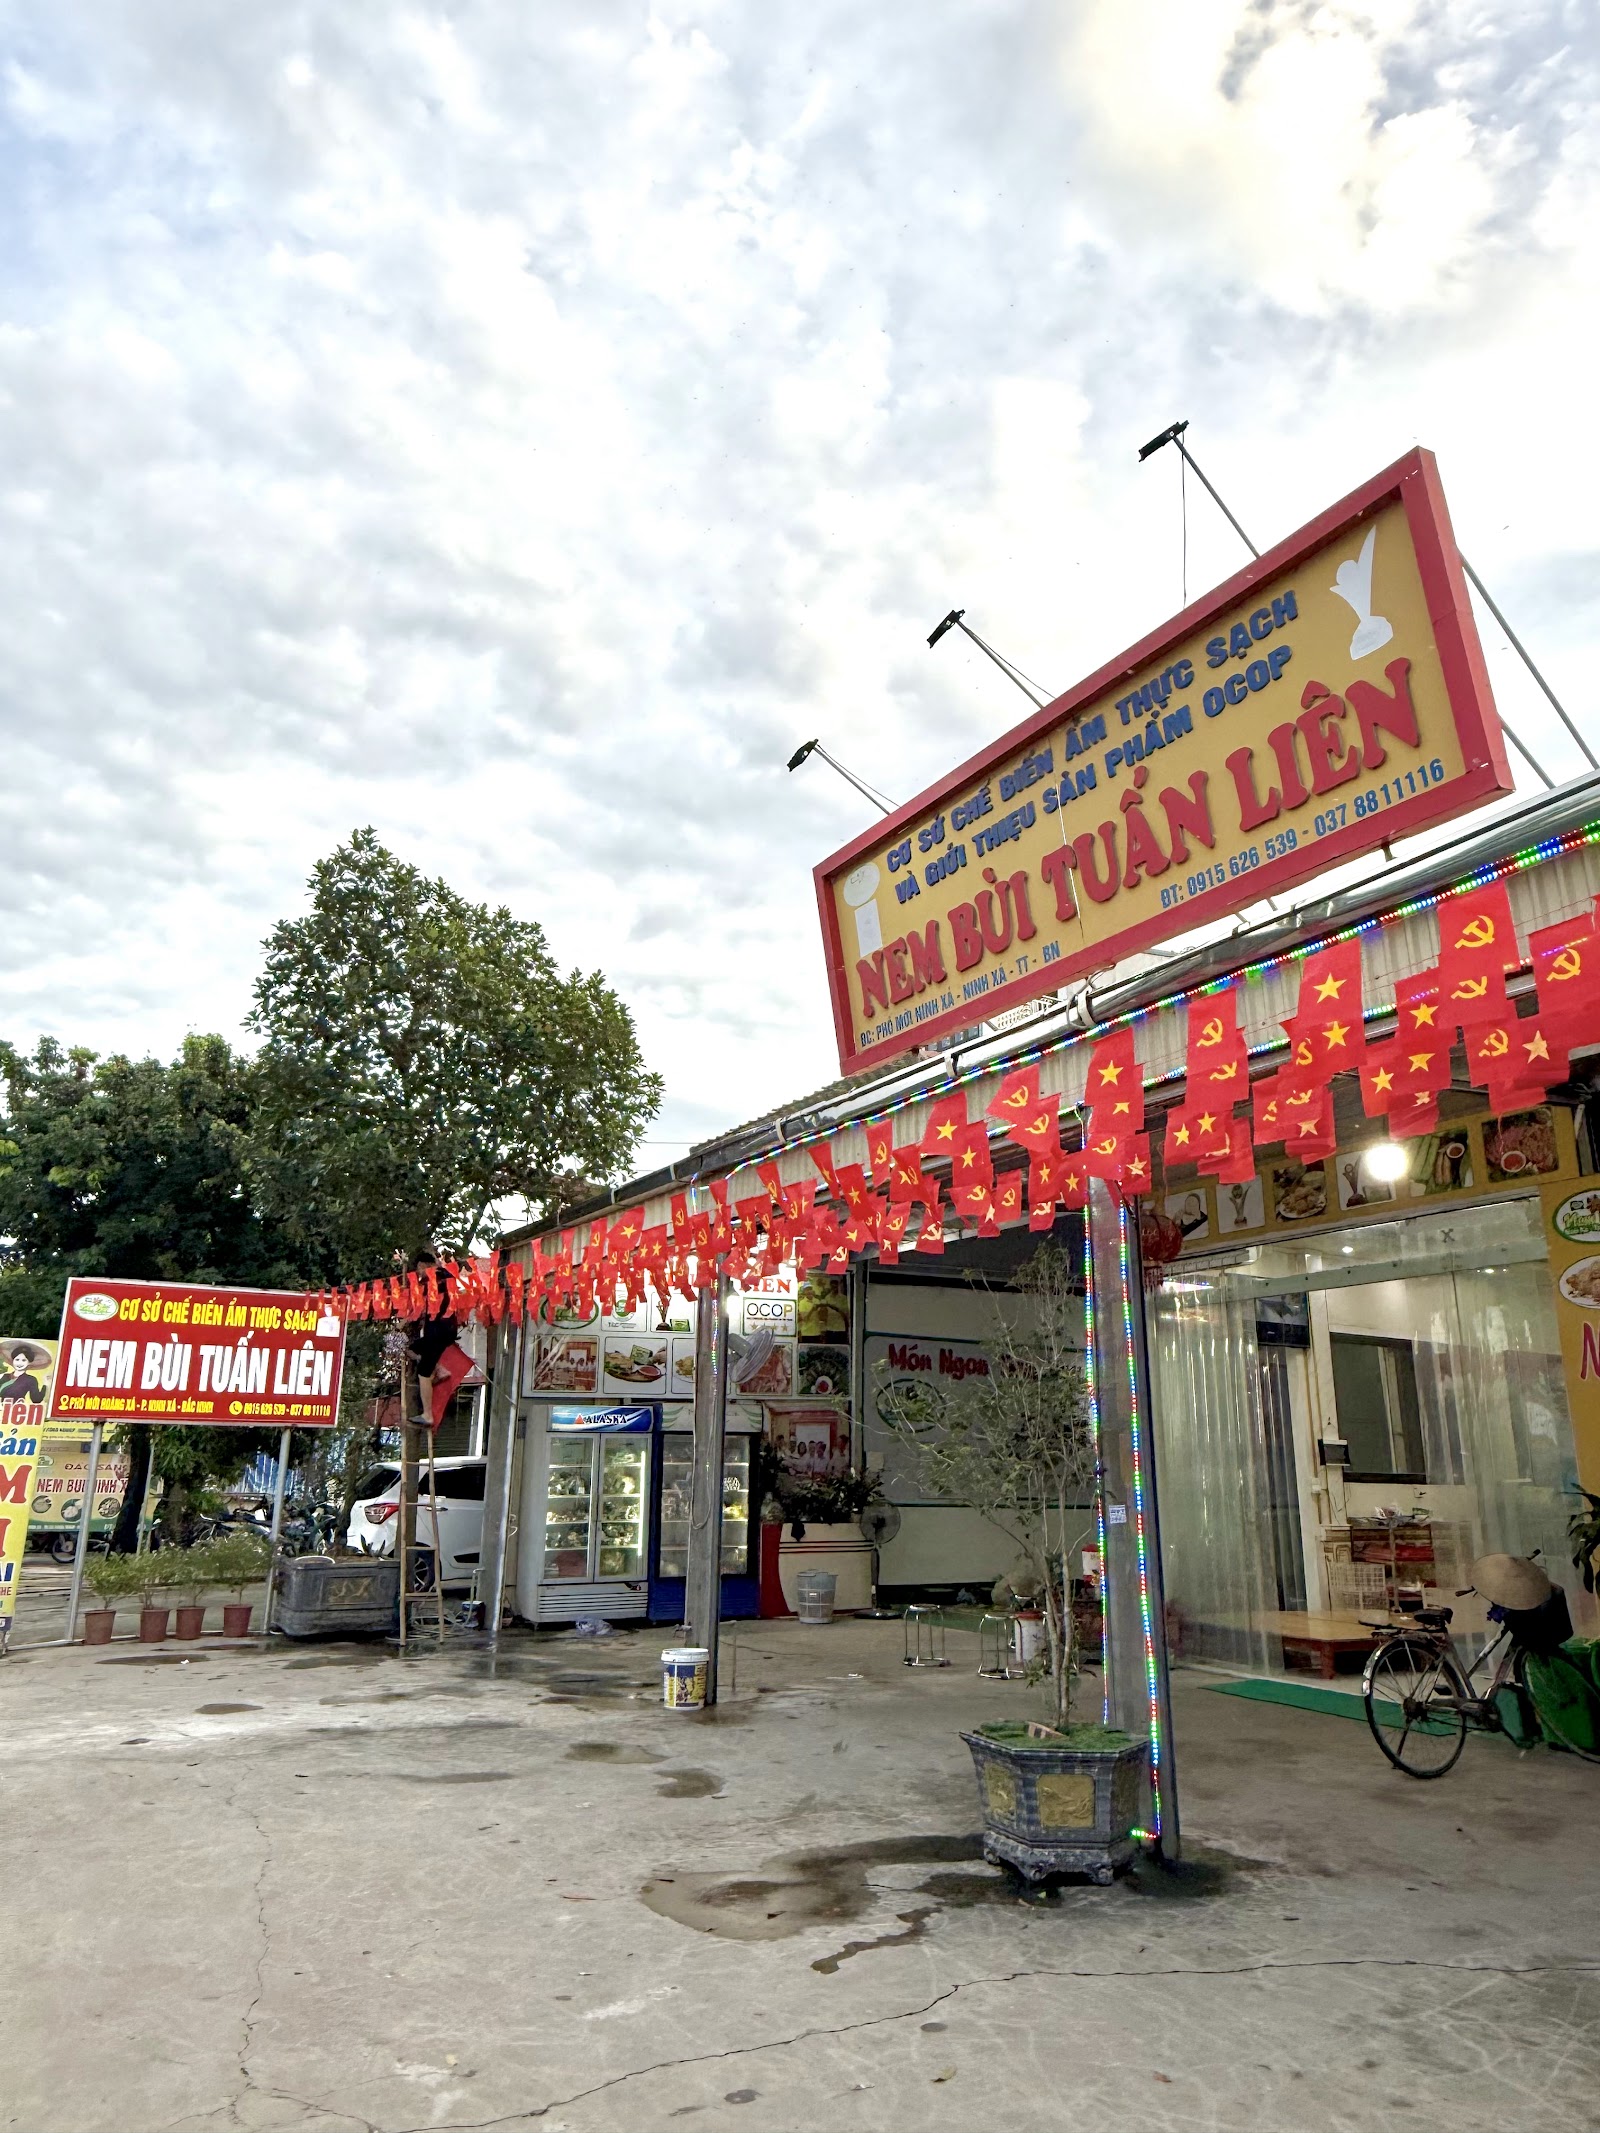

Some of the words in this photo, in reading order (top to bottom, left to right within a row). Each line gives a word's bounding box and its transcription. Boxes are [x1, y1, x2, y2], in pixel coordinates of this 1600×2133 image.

[887, 838, 911, 872] CƠ
[918, 811, 945, 852] SỞ
[951, 777, 993, 831] CHẾ
[999, 748, 1053, 802] BIẾN
[1115, 659, 1194, 725] THỰC
[1206, 590, 1298, 668] SẠCH
[895, 870, 921, 904] VÀ
[925, 842, 967, 886] GIỚI
[972, 801, 1036, 857] THIỆU
[1042, 763, 1097, 814] SẢN
[1105, 704, 1193, 778] PHẨM
[1203, 645, 1292, 718] OCOP
[856, 919, 947, 1018] NEM
[947, 867, 1037, 972] BÙI
[1041, 765, 1216, 922] TUẤN
[1225, 657, 1420, 832] LIÊN
[1186, 862, 1226, 897] 0915
[1228, 846, 1260, 877] 626
[1264, 827, 1298, 860] 539
[1314, 803, 1347, 837] 037
[915, 999, 939, 1022] NINH
[962, 977, 990, 1000] NINH
[1015, 955, 1029, 976] TT
[1042, 940, 1061, 964] BN
[119, 1297, 141, 1321] CƠ
[141, 1291, 162, 1322] SỞ
[163, 1295, 192, 1324] CHẾ
[191, 1297, 224, 1326] BIẾN
[249, 1306, 281, 1333] THỰC
[283, 1308, 317, 1335] SẠCH
[746, 1302, 793, 1317] OCOP
[65, 1338, 138, 1390] NEM
[140, 1332, 192, 1391] BÙI
[198, 1330, 270, 1394] TUẤN
[273, 1339, 333, 1396] LIÊN
[888, 1343, 932, 1371] Món
[939, 1348, 989, 1380] Ngon
[0, 1398, 43, 1426] iên
[584, 1414, 627, 1424] ALASKA
[0, 1428, 37, 1456] ản
[36, 1479, 63, 1493] NEM
[95, 1479, 118, 1493] INH
